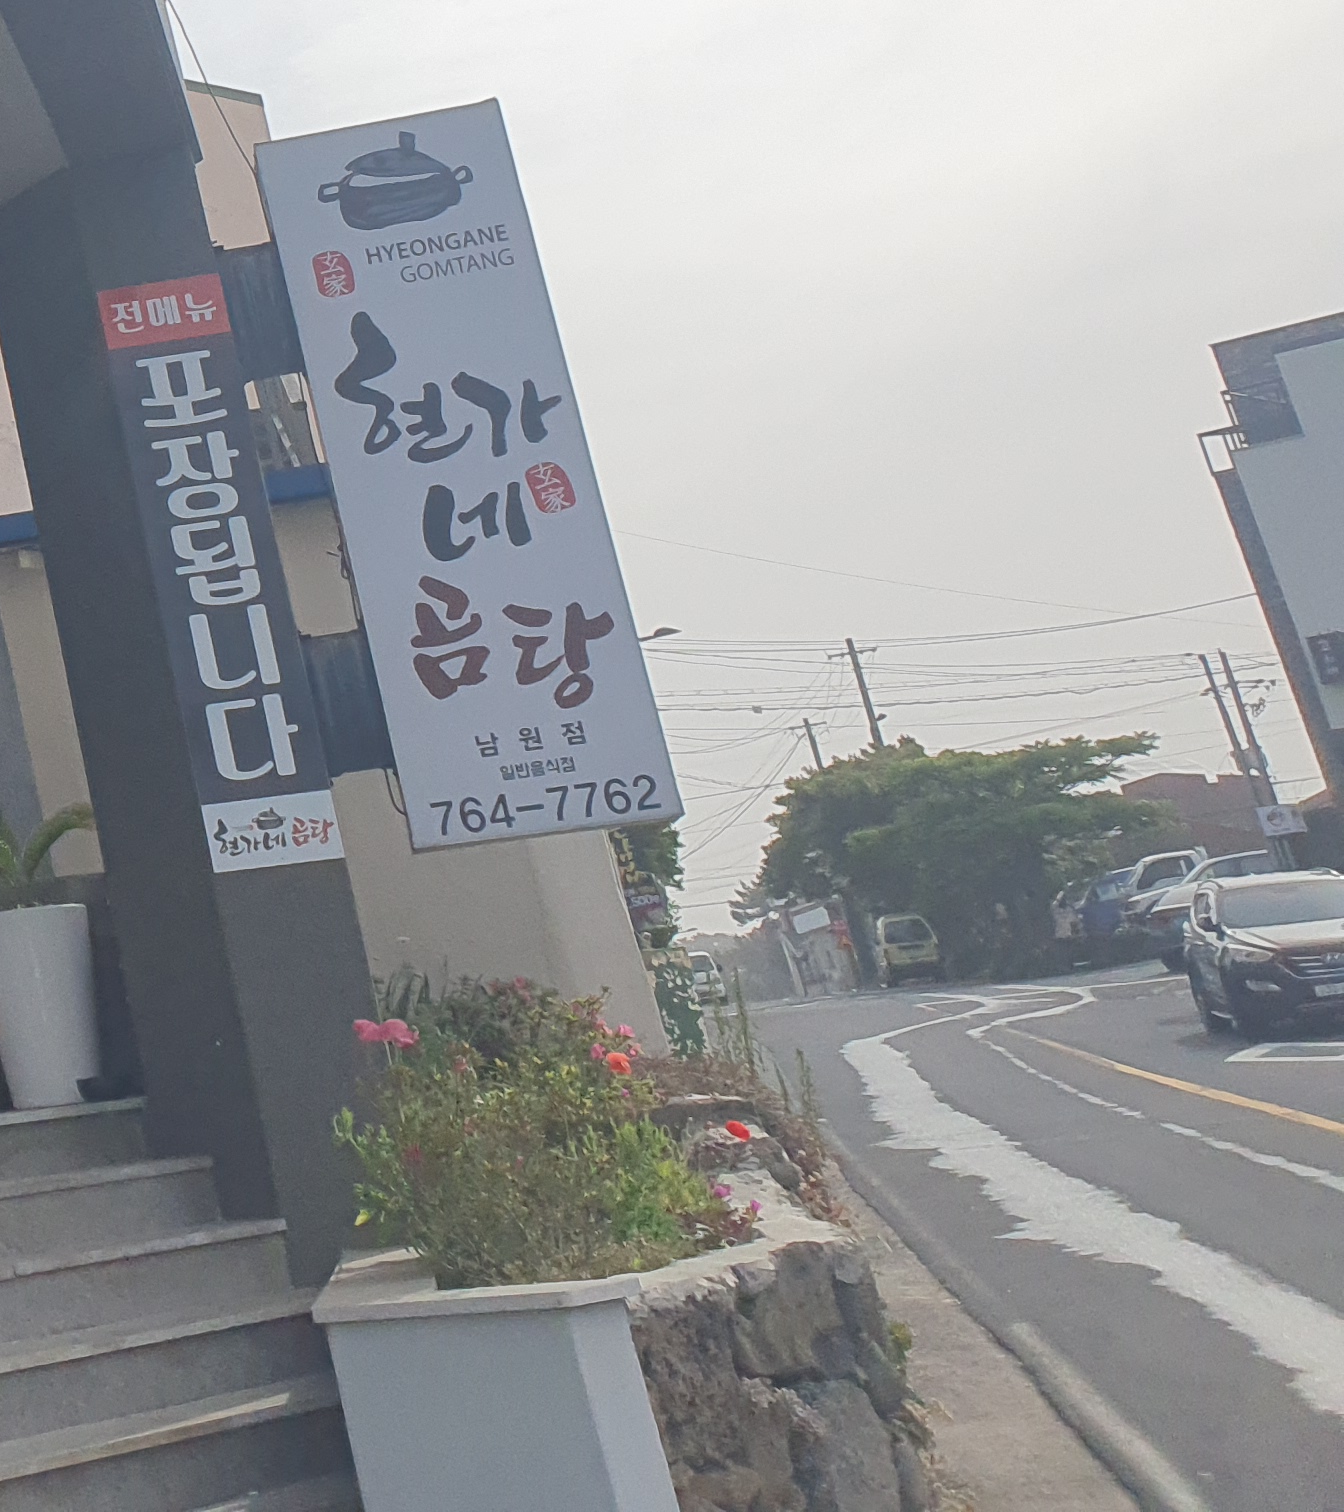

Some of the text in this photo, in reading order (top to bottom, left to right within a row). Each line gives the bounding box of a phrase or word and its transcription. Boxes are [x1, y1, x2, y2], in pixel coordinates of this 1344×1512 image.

[365, 224, 510, 265] HYEONGANE
[400, 248, 516, 283] GOMTANG
[112, 288, 218, 334] 전메뉴
[135, 349, 298, 782] 포장됩니다
[410, 575, 613, 709] 곰탕
[500, 757, 576, 780] 일반음식점
[430, 774, 662, 835] 764-7762
